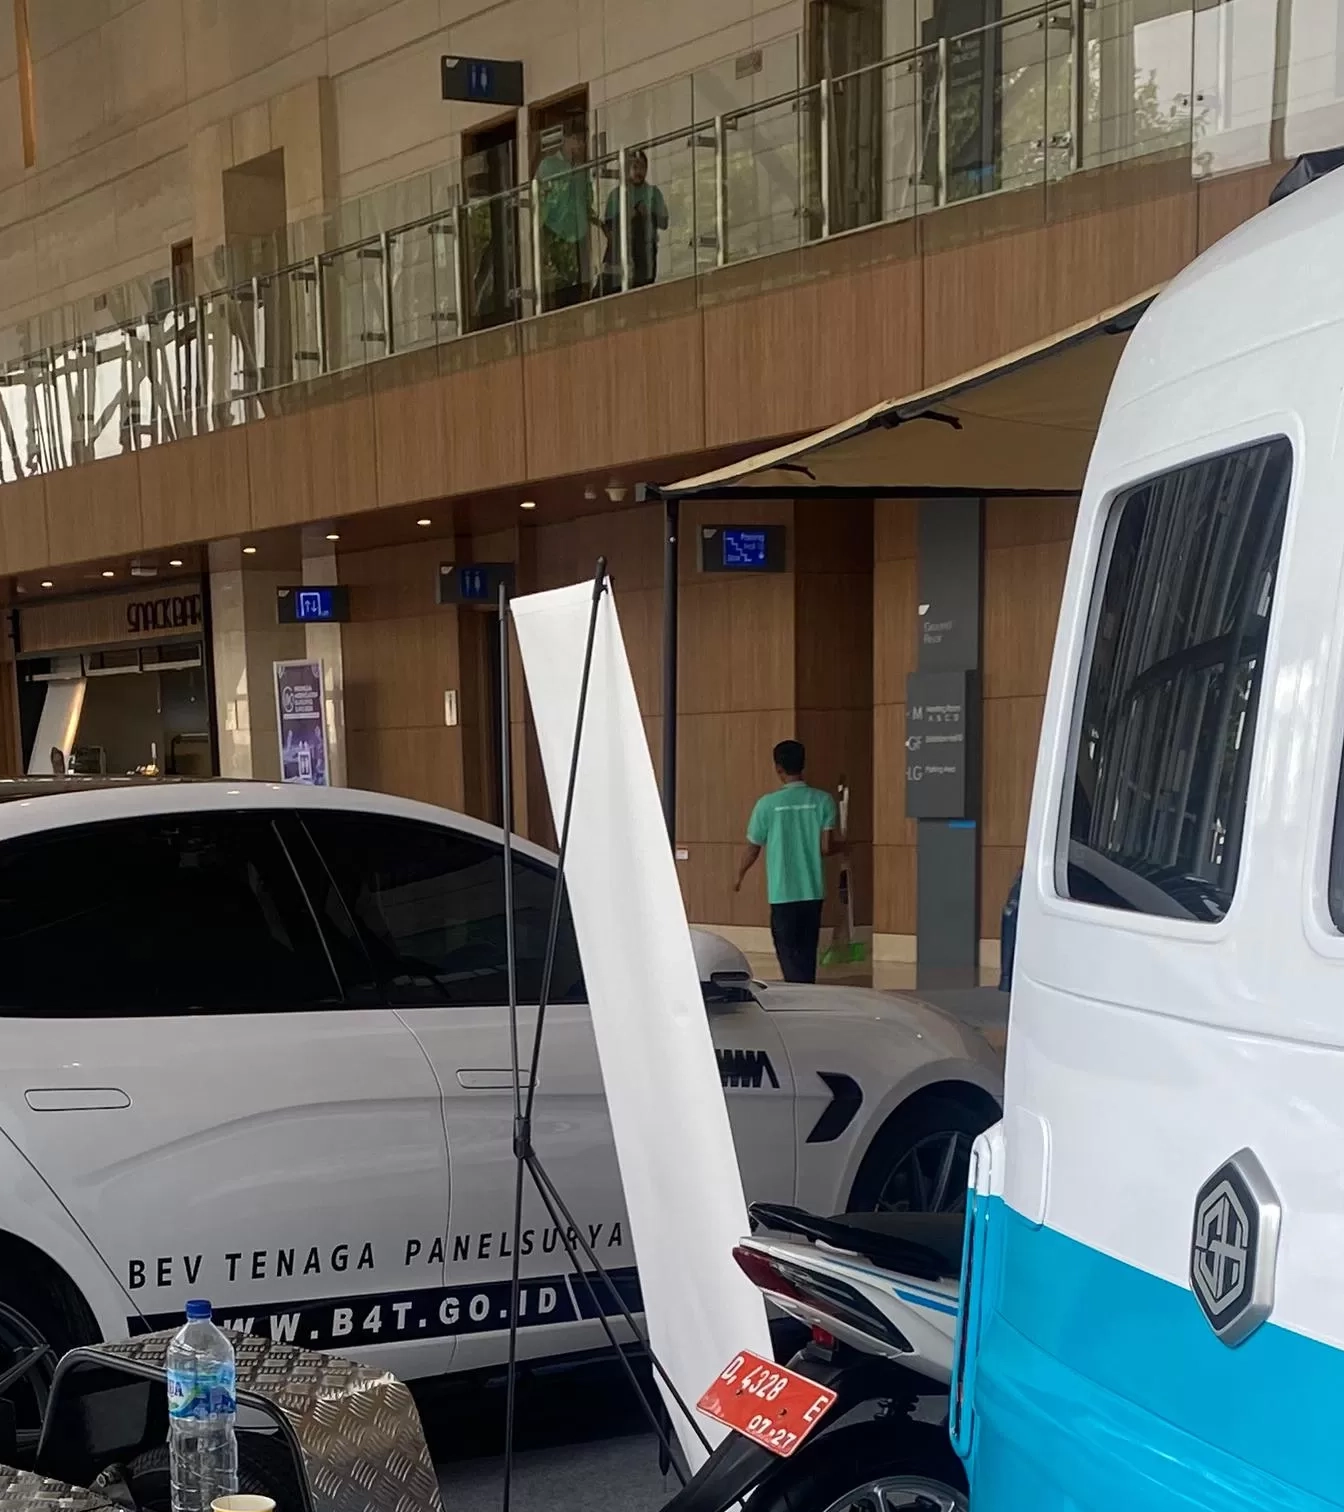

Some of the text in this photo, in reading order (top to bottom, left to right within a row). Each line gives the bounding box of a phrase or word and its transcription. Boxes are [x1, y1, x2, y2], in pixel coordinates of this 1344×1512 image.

[129, 1254, 202, 1290] BEV
[225, 1241, 375, 1281] TENAGA
[741, 1365, 788, 1401] 4328
[803, 1395, 829, 1422] E
